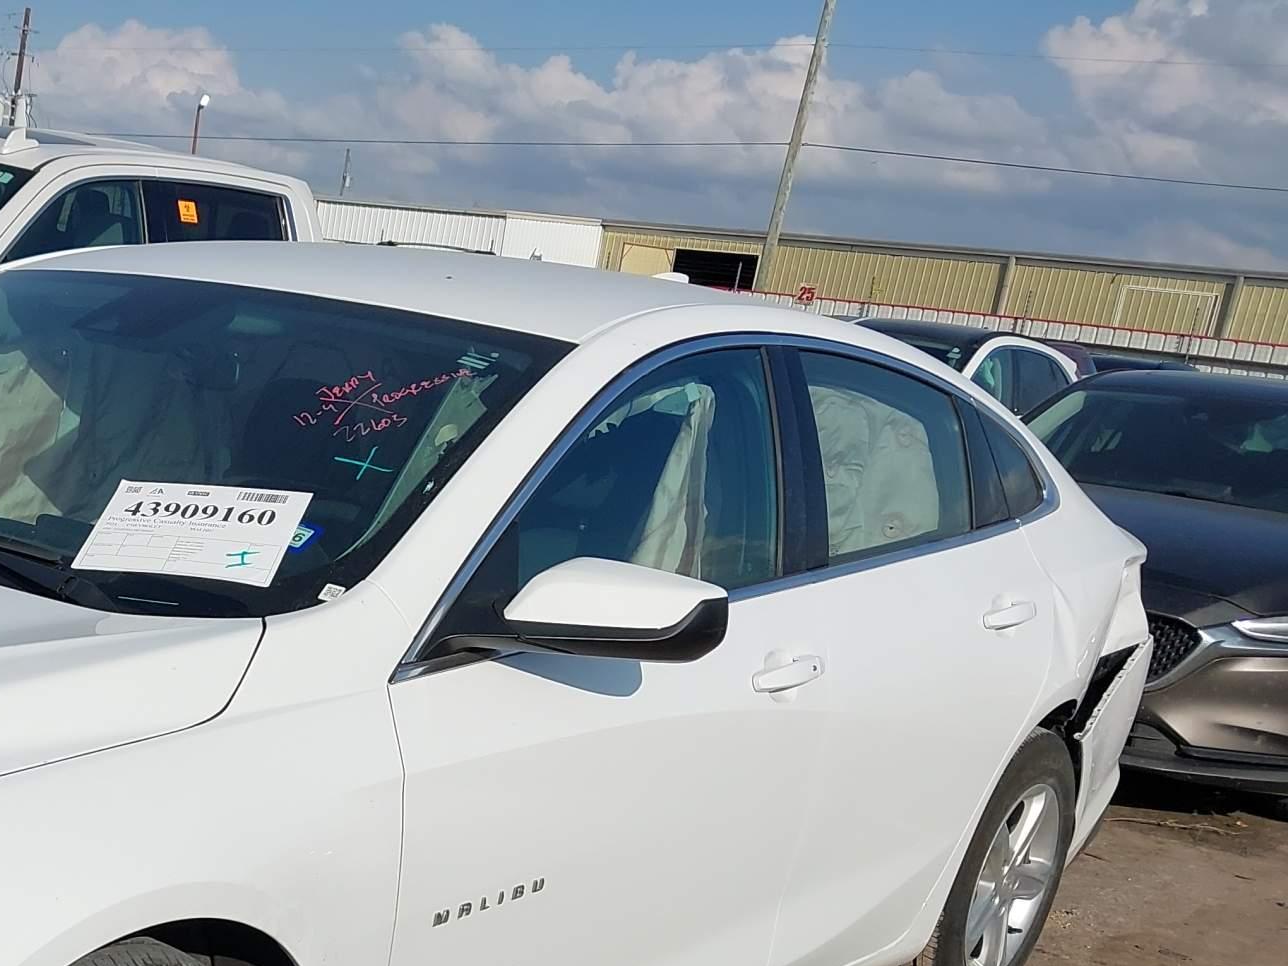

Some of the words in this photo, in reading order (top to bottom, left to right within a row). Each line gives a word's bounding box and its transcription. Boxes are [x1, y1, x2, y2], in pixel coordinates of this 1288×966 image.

[797, 286, 816, 302] 25
[124, 500, 277, 526] 43909160
[432, 878, 545, 928] MALIBU
